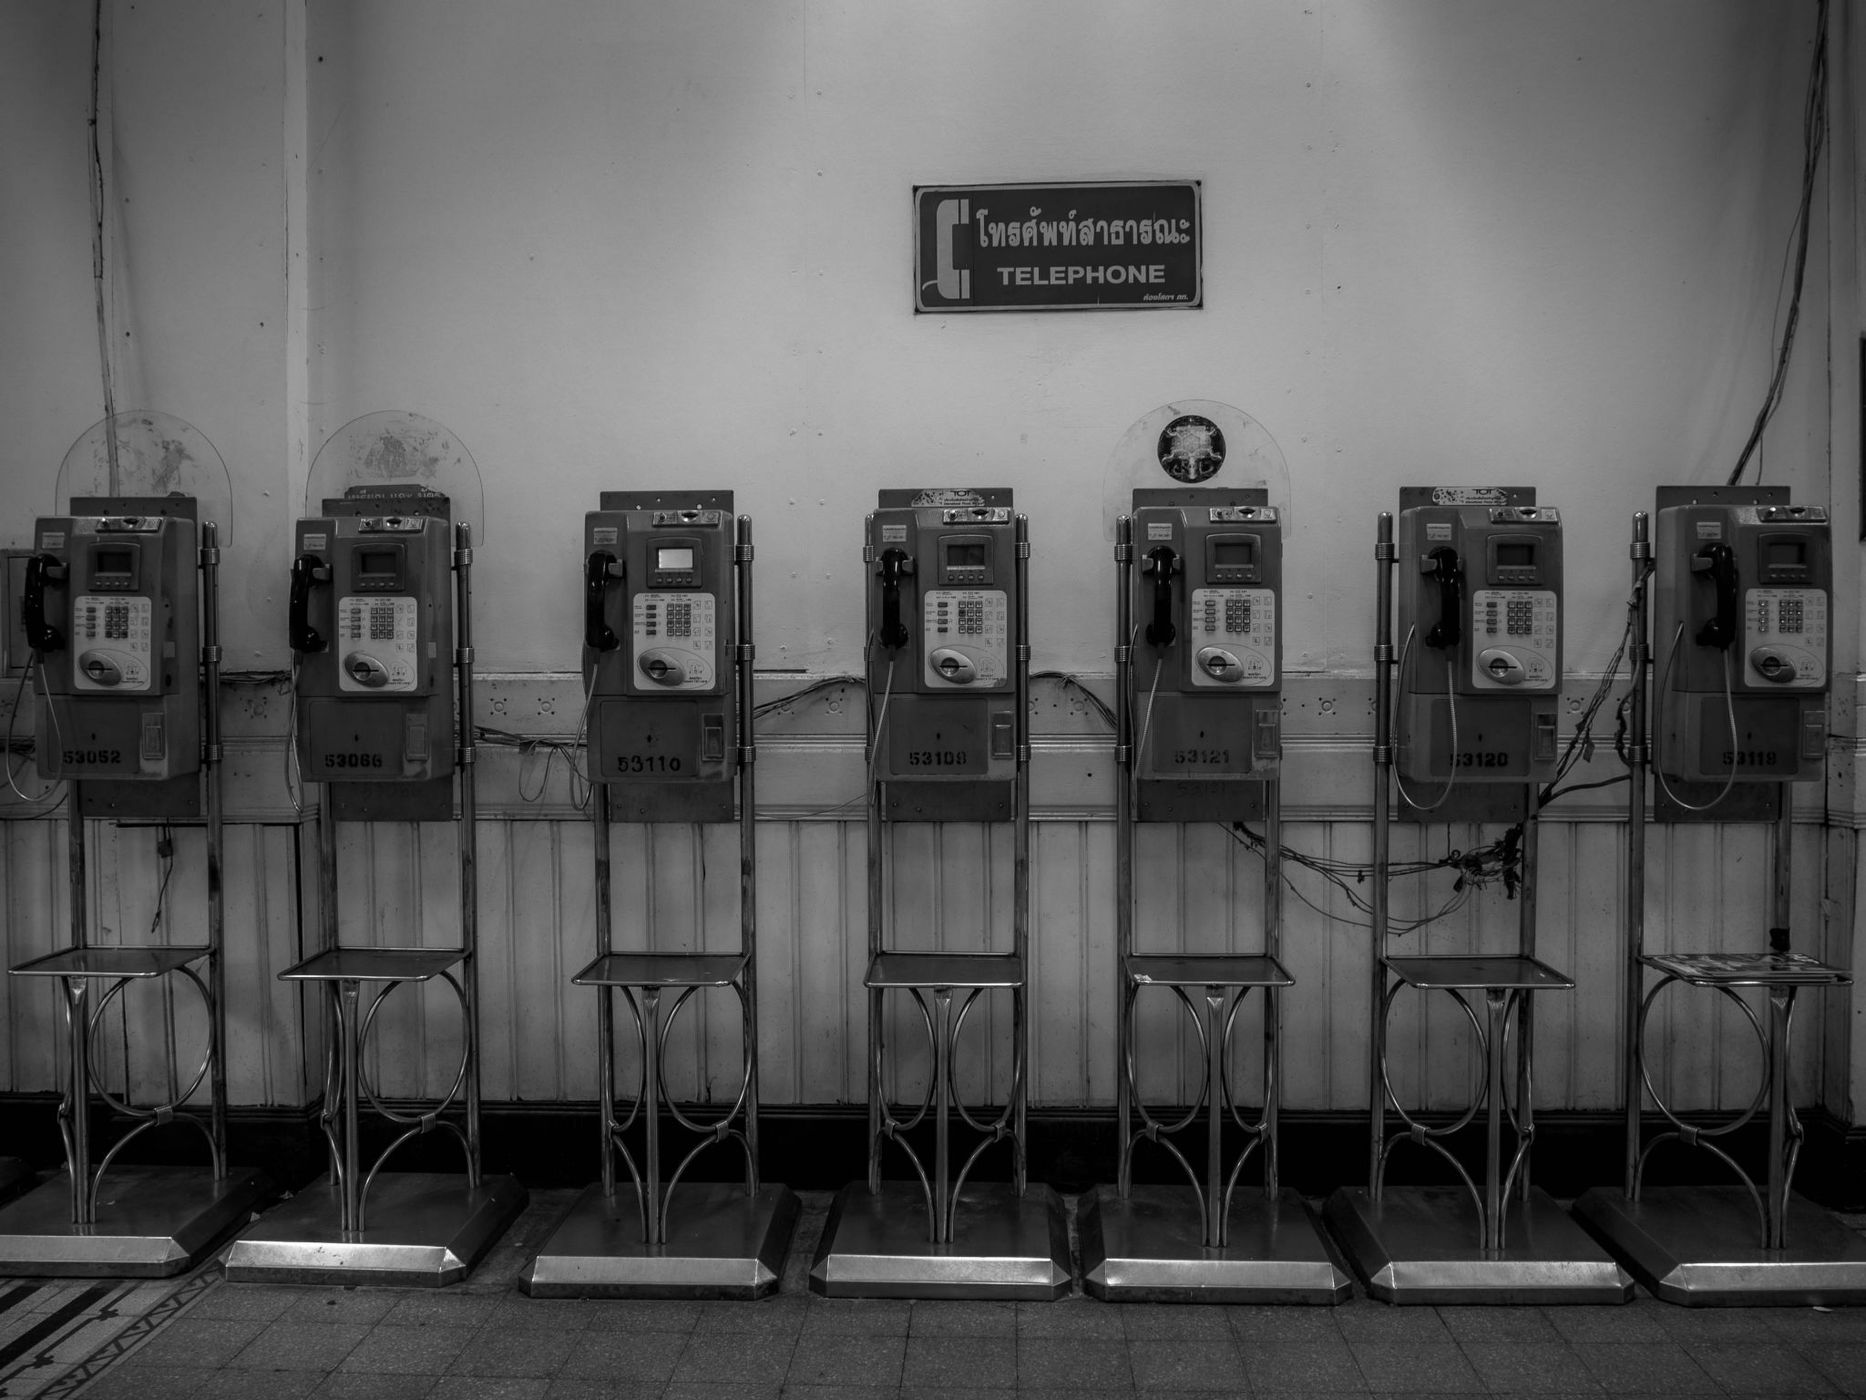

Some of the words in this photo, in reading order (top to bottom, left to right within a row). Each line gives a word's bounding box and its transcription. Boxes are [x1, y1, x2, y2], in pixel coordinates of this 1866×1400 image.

[976, 206, 1191, 248] โทรศัพท์สาธารณะ
[997, 264, 1166, 286] TELEPHONE
[63, 750, 121, 764] 53052
[325, 753, 382, 768] 53066
[617, 755, 681, 773] 53110
[1174, 749, 1229, 764] 53121
[1449, 752, 1508, 767] 53120
